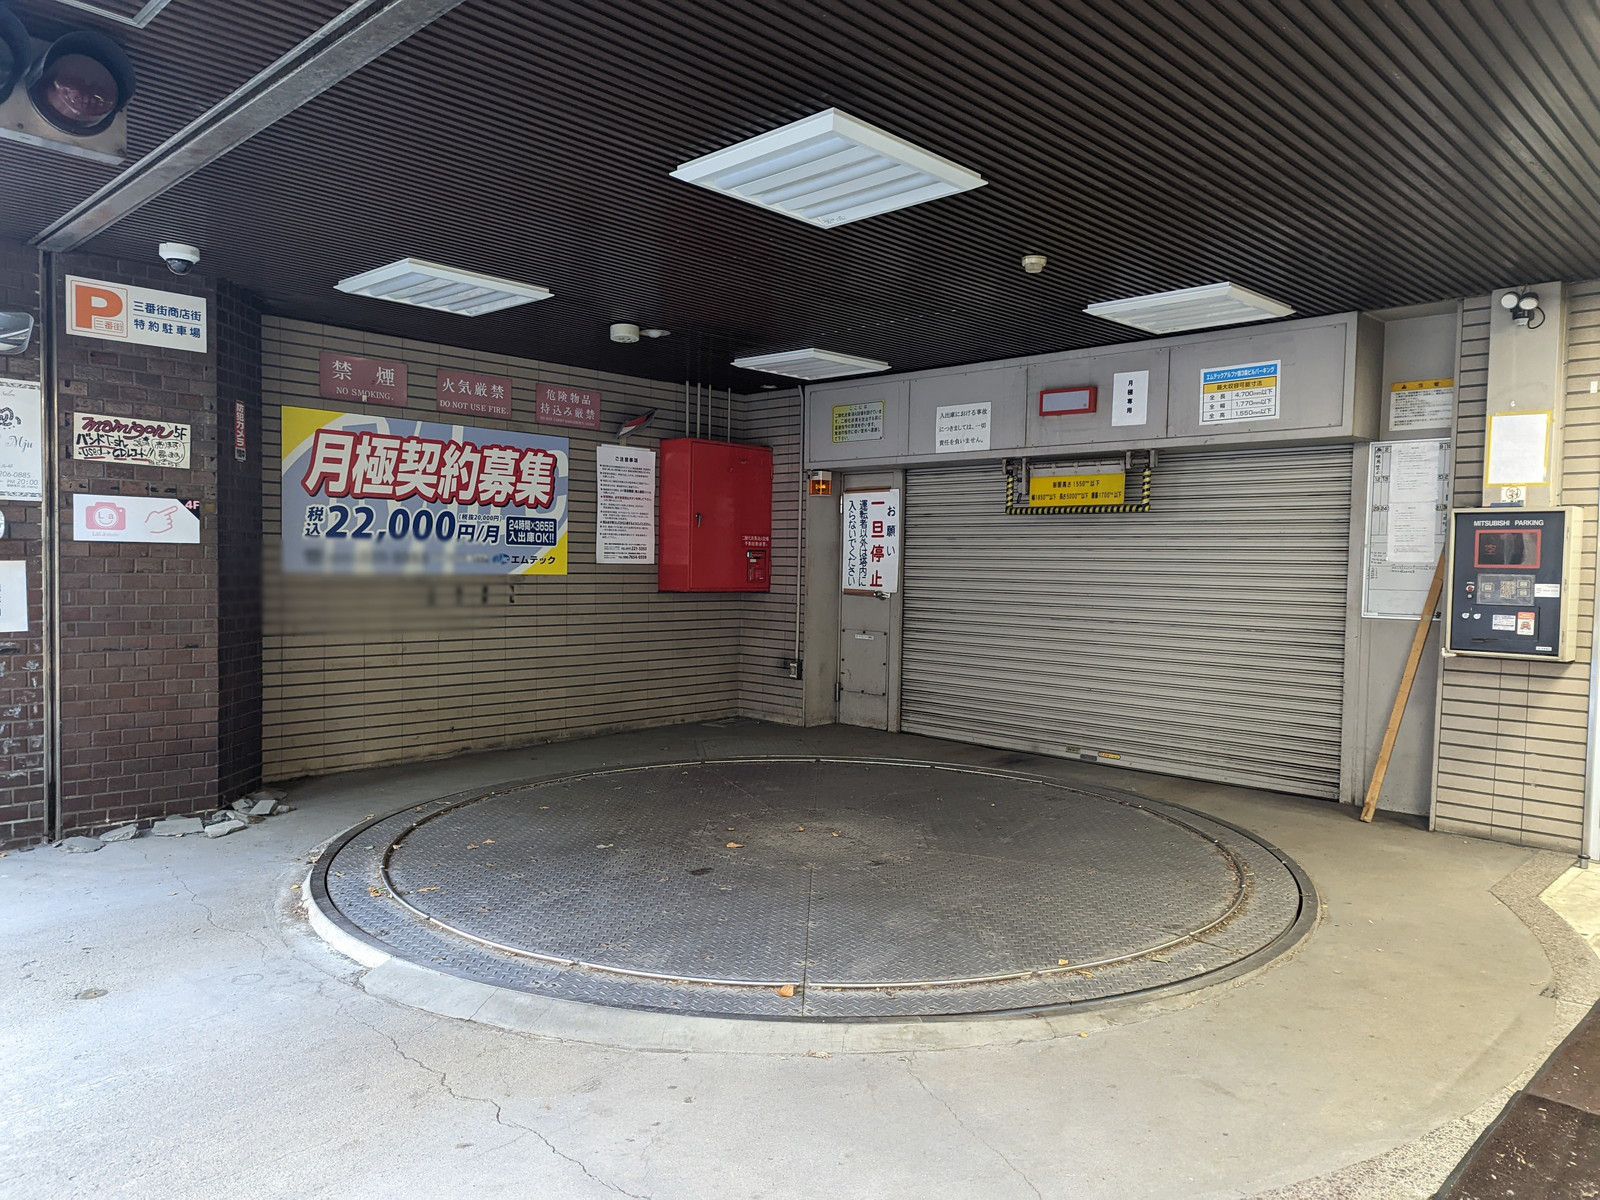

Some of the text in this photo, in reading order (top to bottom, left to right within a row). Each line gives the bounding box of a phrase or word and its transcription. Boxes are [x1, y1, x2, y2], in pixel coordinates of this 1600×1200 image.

[75, 284, 124, 329] P
[133, 300, 202, 322] 三番街商店街
[95, 319, 123, 332] 三番街
[133, 318, 201, 339] 特約駐車場
[331, 359, 396, 387] 禁煙
[336, 386, 394, 401] NO SMOKING.
[442, 377, 505, 400] 火気厳禁
[1216, 380, 1263, 391] 最大収容可能寸法
[546, 389, 591, 406] 危険物品
[439, 399, 509, 415] DO NOT USE FIRE.
[540, 402, 596, 420] 持込み厳禁
[939, 408, 988, 419] 入出庫における事故
[173, 425, 188, 441] 5F
[939, 422, 987, 432] につきましては、一切
[939, 437, 984, 447] 責任を負いません。
[303, 430, 557, 507] 月極契約募集
[16, 479, 39, 487] 20:00
[184, 500, 200, 510] 4F
[305, 505, 325, 538] 税込
[508, 531, 555, 544] 入出庫OK!!
[886, 505, 896, 557] お願い
[847, 500, 857, 587] 入らないでください
[869, 501, 885, 588] 一旦停止
[511, 555, 556, 565] エムテック
